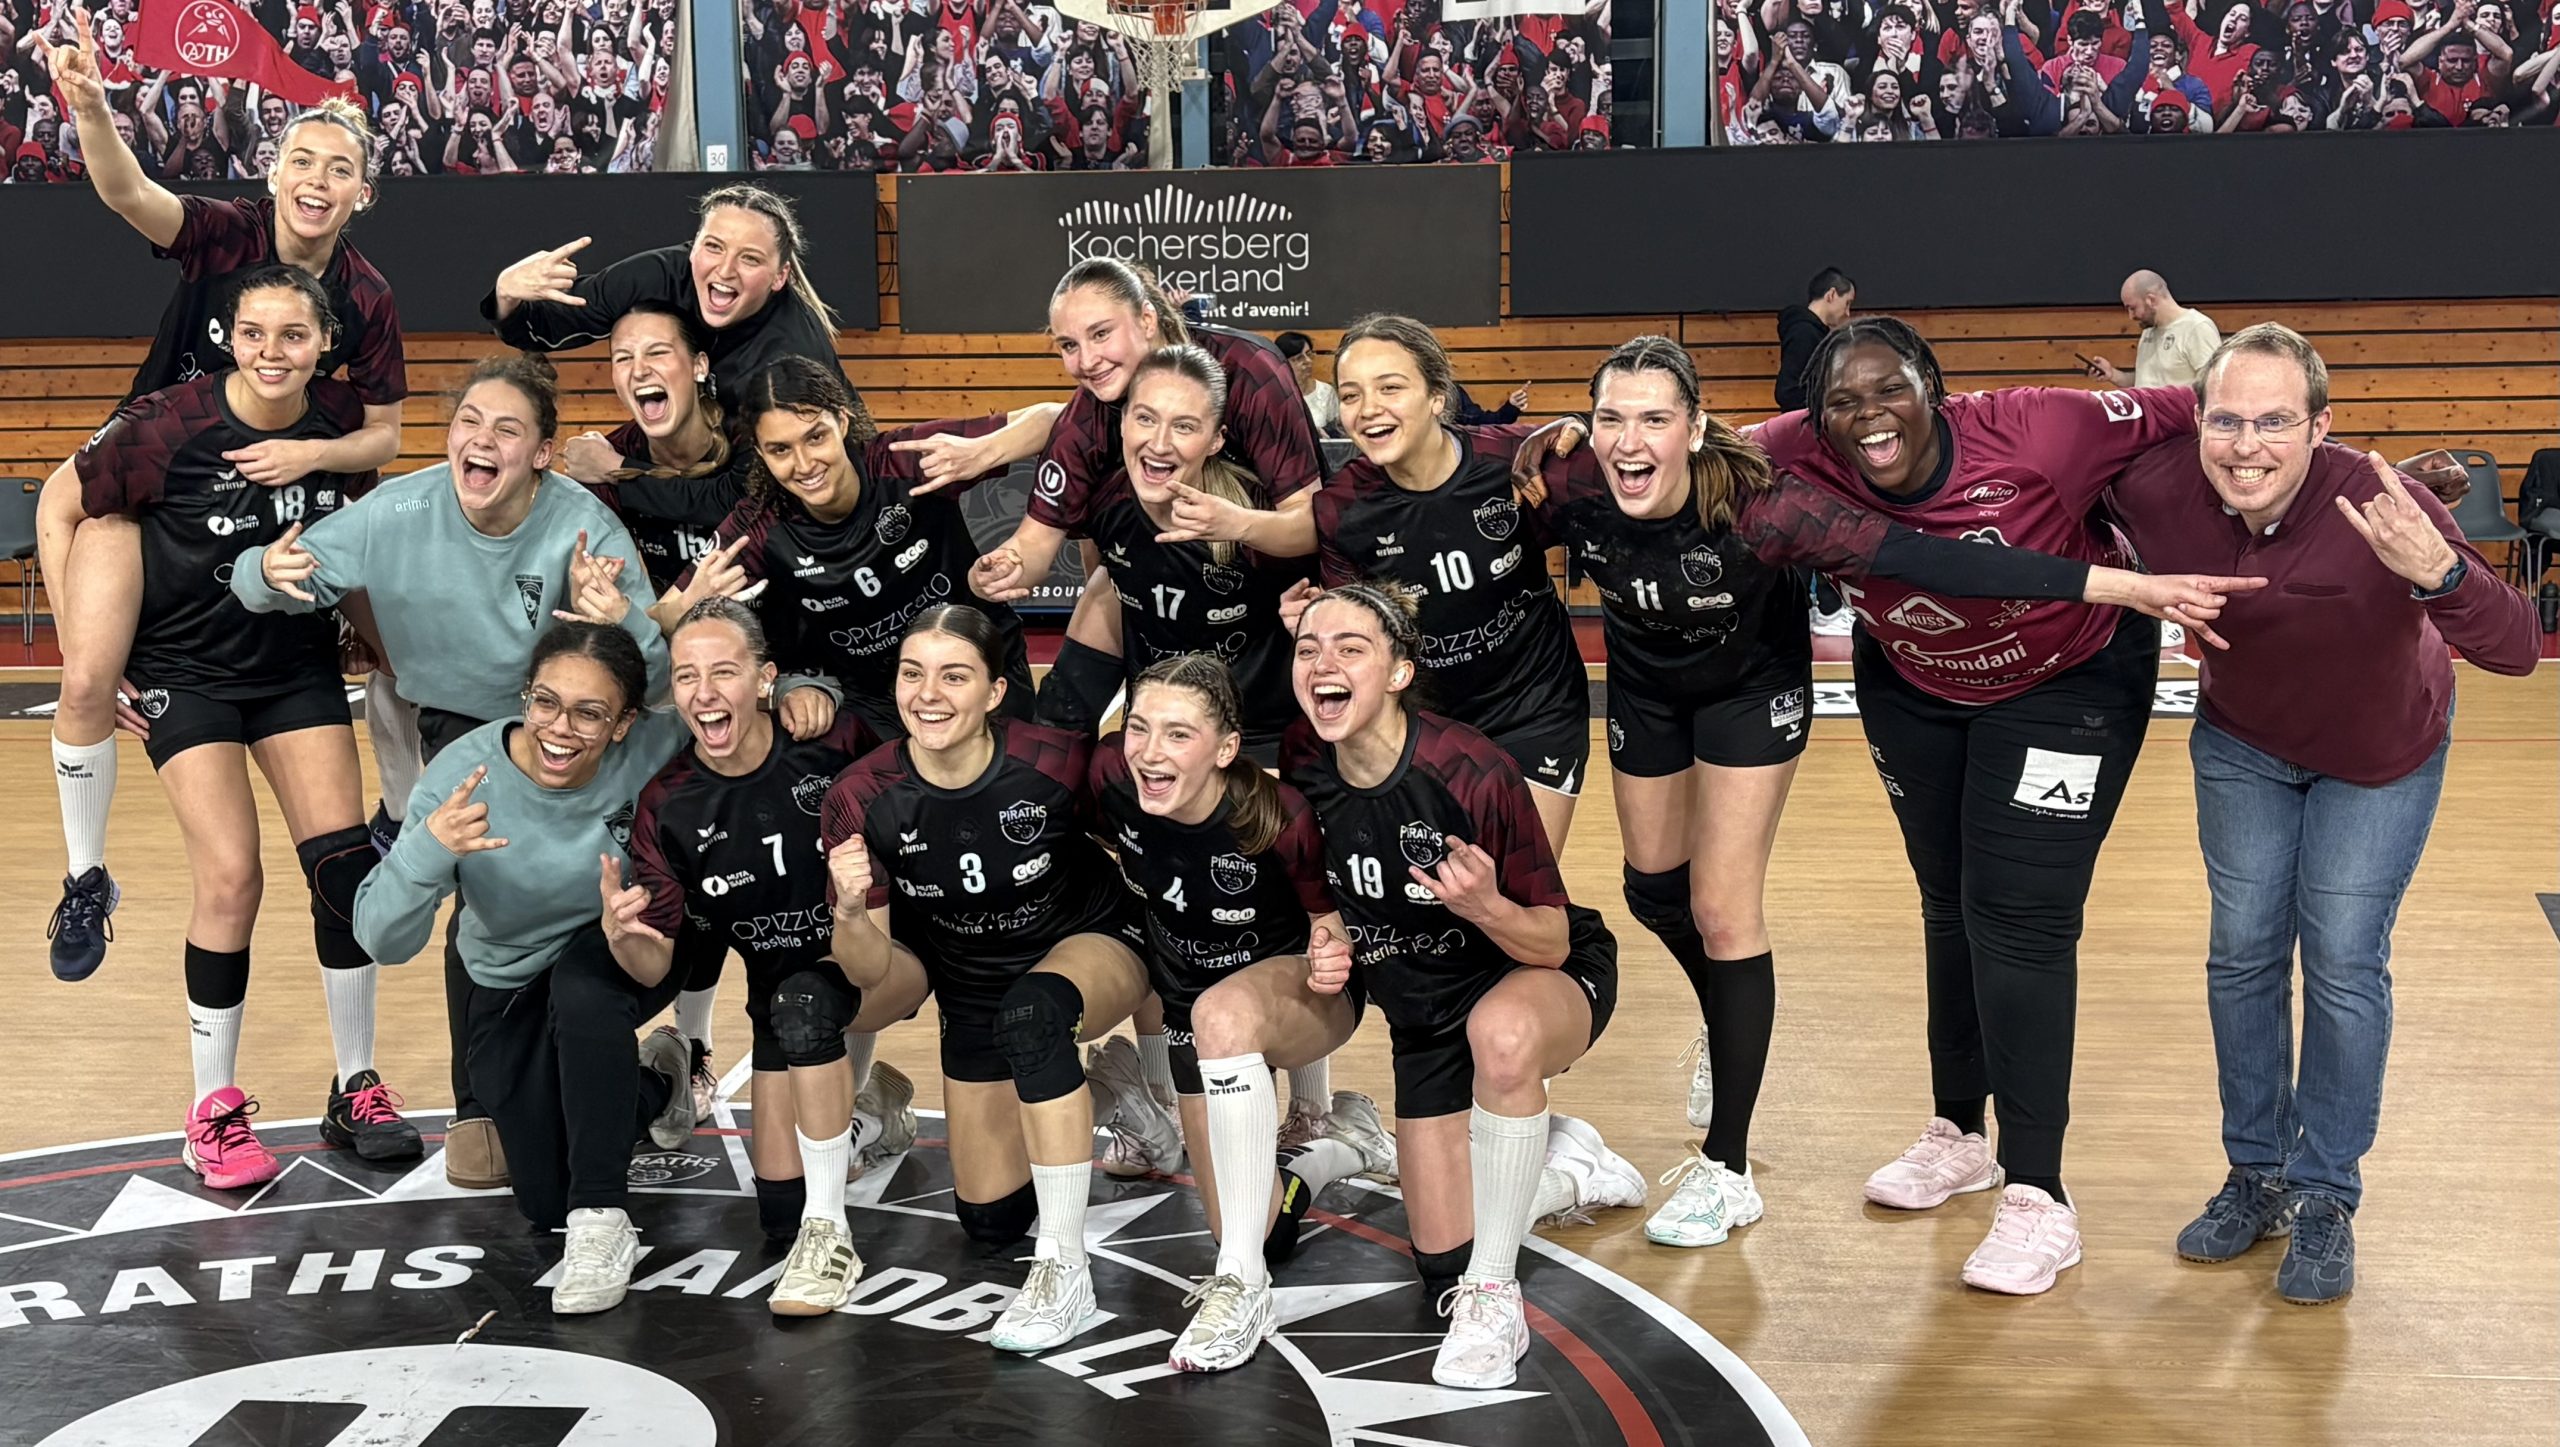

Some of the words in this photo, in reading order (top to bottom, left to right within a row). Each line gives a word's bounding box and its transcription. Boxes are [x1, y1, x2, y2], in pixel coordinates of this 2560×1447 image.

[710, 152, 726, 166] 30
[1067, 225, 1309, 270] Kochersberg
[1157, 262, 1284, 292] kerland
[213, 480, 247, 492] erima
[268, 484, 306, 526] 18
[395, 498, 430, 513] erima
[1472, 500, 1519, 523] PIRATHS
[672, 524, 707, 561] 15
[1430, 549, 1475, 594] 10
[1680, 551, 1723, 568] PIRATHS
[853, 566, 882, 598] 6
[1630, 577, 1665, 612] 11
[1150, 583, 1186, 621] 17
[1905, 613, 1947, 627] NUSS
[999, 804, 1048, 824] PIRATHS
[373, 826, 395, 847] LACO
[761, 832, 787, 877] 7
[1211, 855, 1258, 875] PIRATHS
[726, 870, 750, 881] MUTA
[959, 852, 987, 894] 3
[1346, 853, 1385, 899] 19
[1162, 876, 1188, 913] 4
[1208, 1084, 1251, 1096] erima
[629, 1156, 721, 1168] RATHS
[0, 1245, 486, 1329] RATHS
